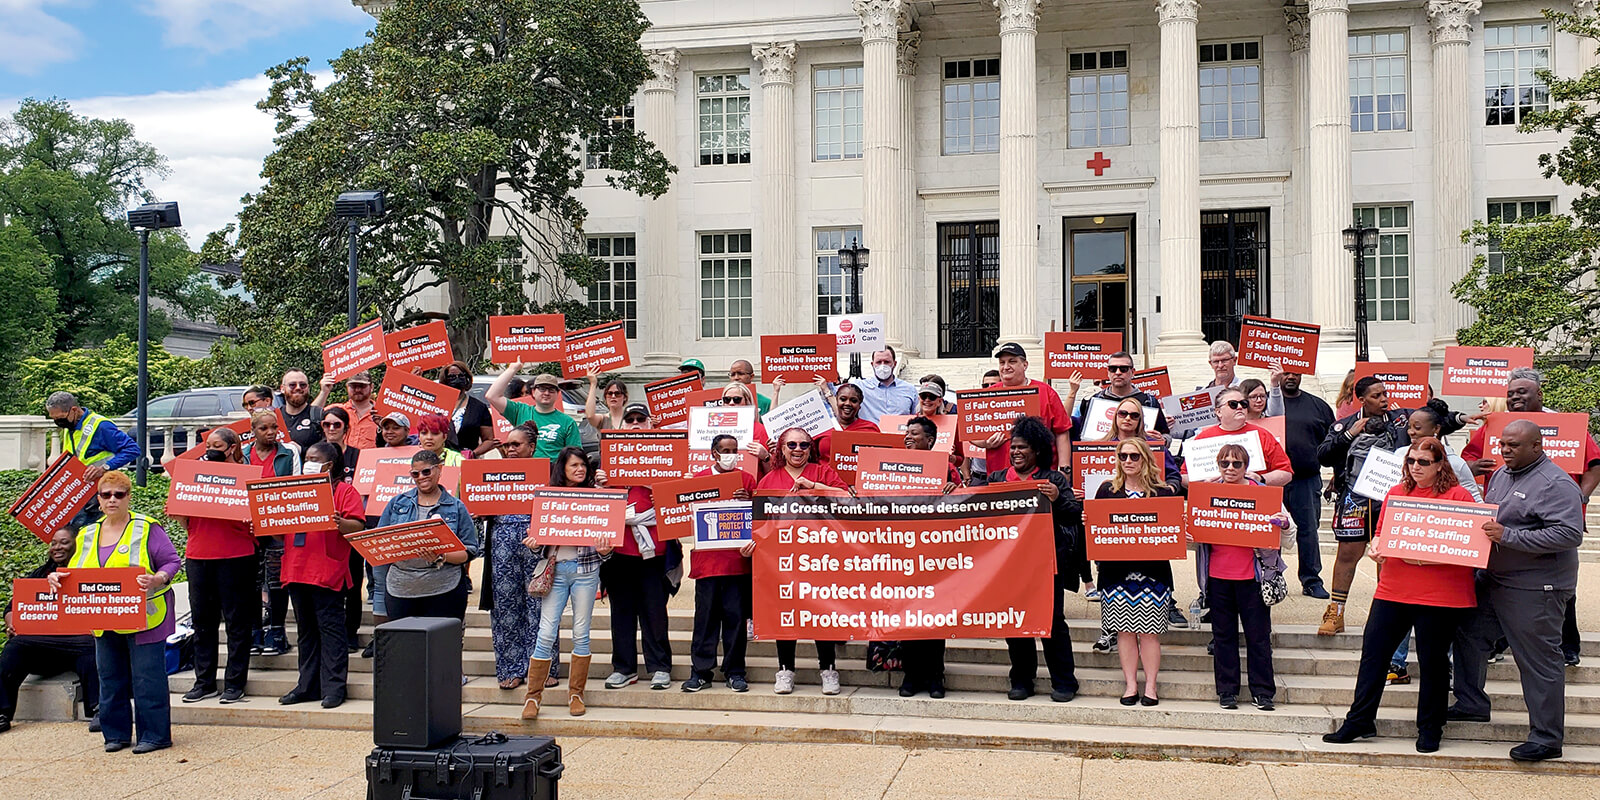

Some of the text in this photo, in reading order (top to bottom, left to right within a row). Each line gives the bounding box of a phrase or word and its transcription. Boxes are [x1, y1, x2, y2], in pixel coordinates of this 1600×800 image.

[524, 326, 544, 334] Cross:
[496, 336, 533, 344] Front-line
[1256, 330, 1304, 344] Fair Contract
[530, 342, 560, 352] respect
[570, 342, 584, 352] Fair
[584, 334, 614, 347] Contract
[1254, 341, 1304, 356] Safe Staffing
[573, 345, 616, 362] Safe Staffing
[1048, 352, 1088, 360] Front-line
[765, 356, 804, 364] Front-line
[1051, 360, 1084, 368] deserve
[1282, 358, 1310, 368] Donors
[768, 364, 831, 372] deserve respect
[1448, 366, 1492, 376] Front-line
[1450, 375, 1487, 384] deserve
[972, 399, 1025, 410] Fair Contract
[768, 408, 788, 422] Exposed
[795, 400, 810, 410] Covid
[974, 412, 992, 421] Safe
[772, 420, 795, 434] American
[806, 408, 822, 418] Cross
[1178, 418, 1194, 426] HELP
[974, 424, 1005, 433] Protect
[618, 443, 672, 452] Fair Contract
[618, 456, 673, 466] Safe Staffing
[1376, 456, 1402, 470] Exposed
[619, 468, 682, 478] Protect Donors
[898, 464, 922, 472] Cross:
[197, 475, 236, 485] Red Cross:
[860, 472, 942, 486] Front-line heroes
[1365, 475, 1387, 488] Forced
[1368, 469, 1398, 484] American
[30, 470, 72, 513] Fair Contract
[175, 482, 220, 494] Front-line
[466, 484, 511, 492] Front-line
[1372, 486, 1384, 494] but
[40, 502, 58, 520] Safe
[54, 478, 82, 505] Staffing
[176, 492, 214, 503] deserve
[264, 490, 318, 502] Fair Contract
[468, 493, 506, 502] deserve
[679, 490, 719, 502] Red Cross:
[266, 502, 319, 514] Safe Staffing
[550, 502, 610, 512] Fair Contract
[764, 496, 1039, 515] Red Cross: Front-line heroes deserve respect
[1213, 498, 1254, 509] Red Cross:
[50, 502, 74, 528] Protect
[718, 512, 744, 520] RESPECT
[1112, 514, 1156, 522] Red Cross:
[1192, 506, 1239, 520] Front-line
[269, 514, 330, 527] Protect Donors
[550, 514, 608, 526] Safe Staffing
[1194, 517, 1273, 534] deserve respect
[1404, 512, 1474, 528] Fair Contract
[719, 522, 744, 530] PROTECT
[1090, 524, 1180, 534] Front-line heroes
[548, 528, 582, 538] Protect
[719, 530, 740, 539] PAY US!
[796, 522, 1020, 549] Safe working conditions
[1402, 526, 1470, 545] Safe Staffing
[1094, 534, 1178, 546] deserve respect
[1398, 540, 1479, 558] Protect Donors
[798, 552, 974, 576] Safe staffing levels
[81, 584, 120, 592] Red Cross:
[798, 582, 936, 600] Protect donors
[62, 594, 142, 604] Front-line heroes
[64, 604, 139, 616] deserve respect
[799, 607, 1026, 629] Protect the blood supply
